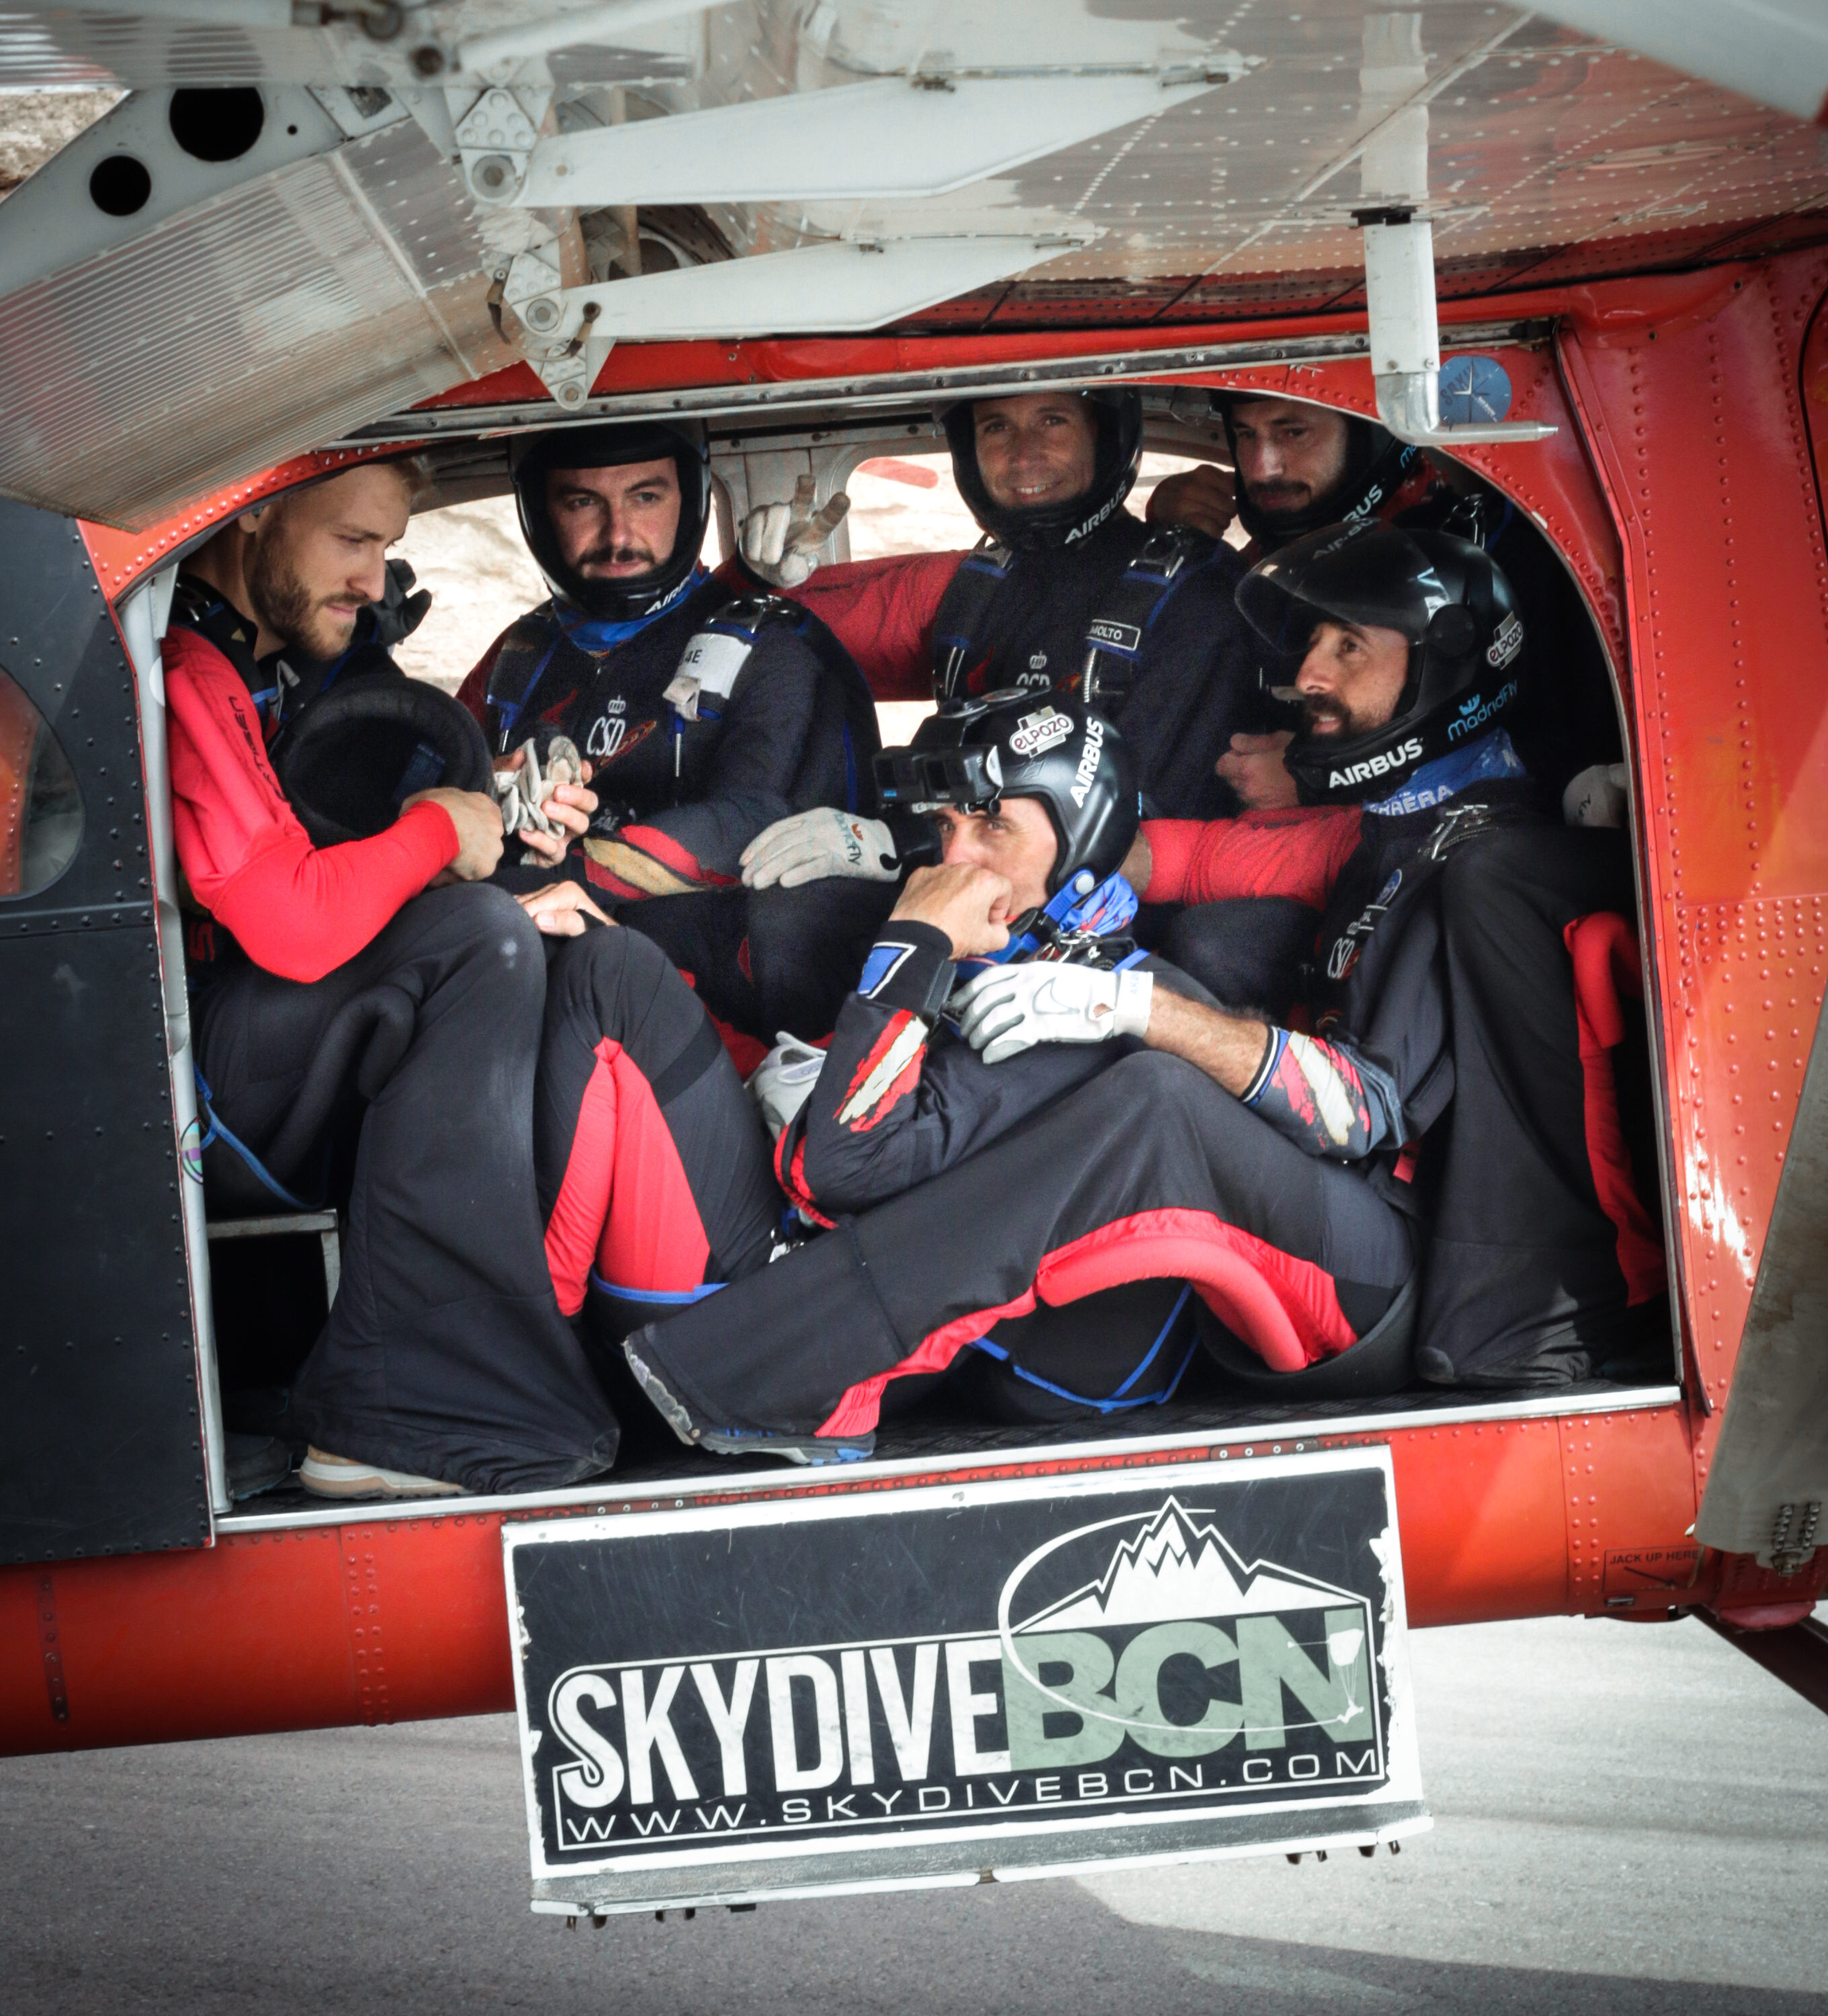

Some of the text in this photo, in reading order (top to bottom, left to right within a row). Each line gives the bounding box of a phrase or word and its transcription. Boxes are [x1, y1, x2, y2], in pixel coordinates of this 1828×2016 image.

[1065, 480, 1127, 544] AIRBUS
[586, 716, 626, 757] CSD
[1070, 716, 1104, 808] AIRBUS
[1329, 737, 1423, 789] AIRBUS
[1610, 1550, 1698, 1564] JACK UP HERE
[567, 1749, 1376, 1843] WWW.SKYDIVEBCN.COM
